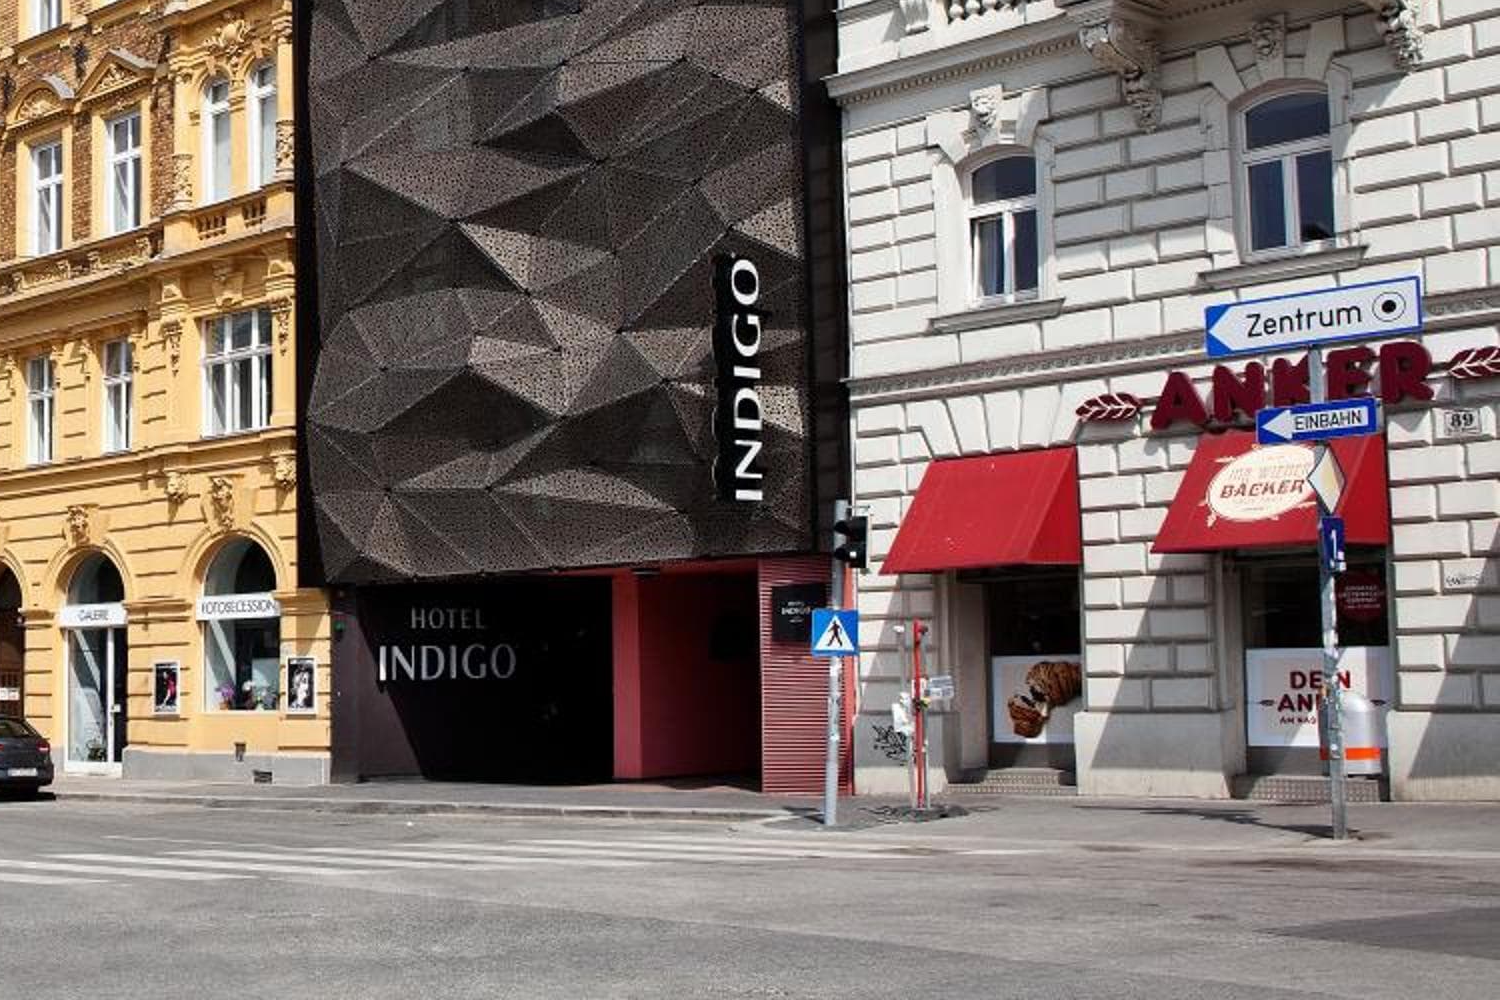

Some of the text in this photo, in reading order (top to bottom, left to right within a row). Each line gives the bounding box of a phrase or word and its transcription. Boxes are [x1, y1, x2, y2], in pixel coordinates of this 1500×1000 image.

[1246, 304, 1362, 338] Zentrum
[731, 259, 764, 501] INDIGO
[1150, 341, 1435, 431] ANKER
[1294, 410, 1363, 432] EINBAHN
[1450, 413, 1474, 428] 89
[411, 607, 486, 630] HOTEL
[379, 643, 517, 682] INDIGO
[1289, 670, 1351, 690] DEN
